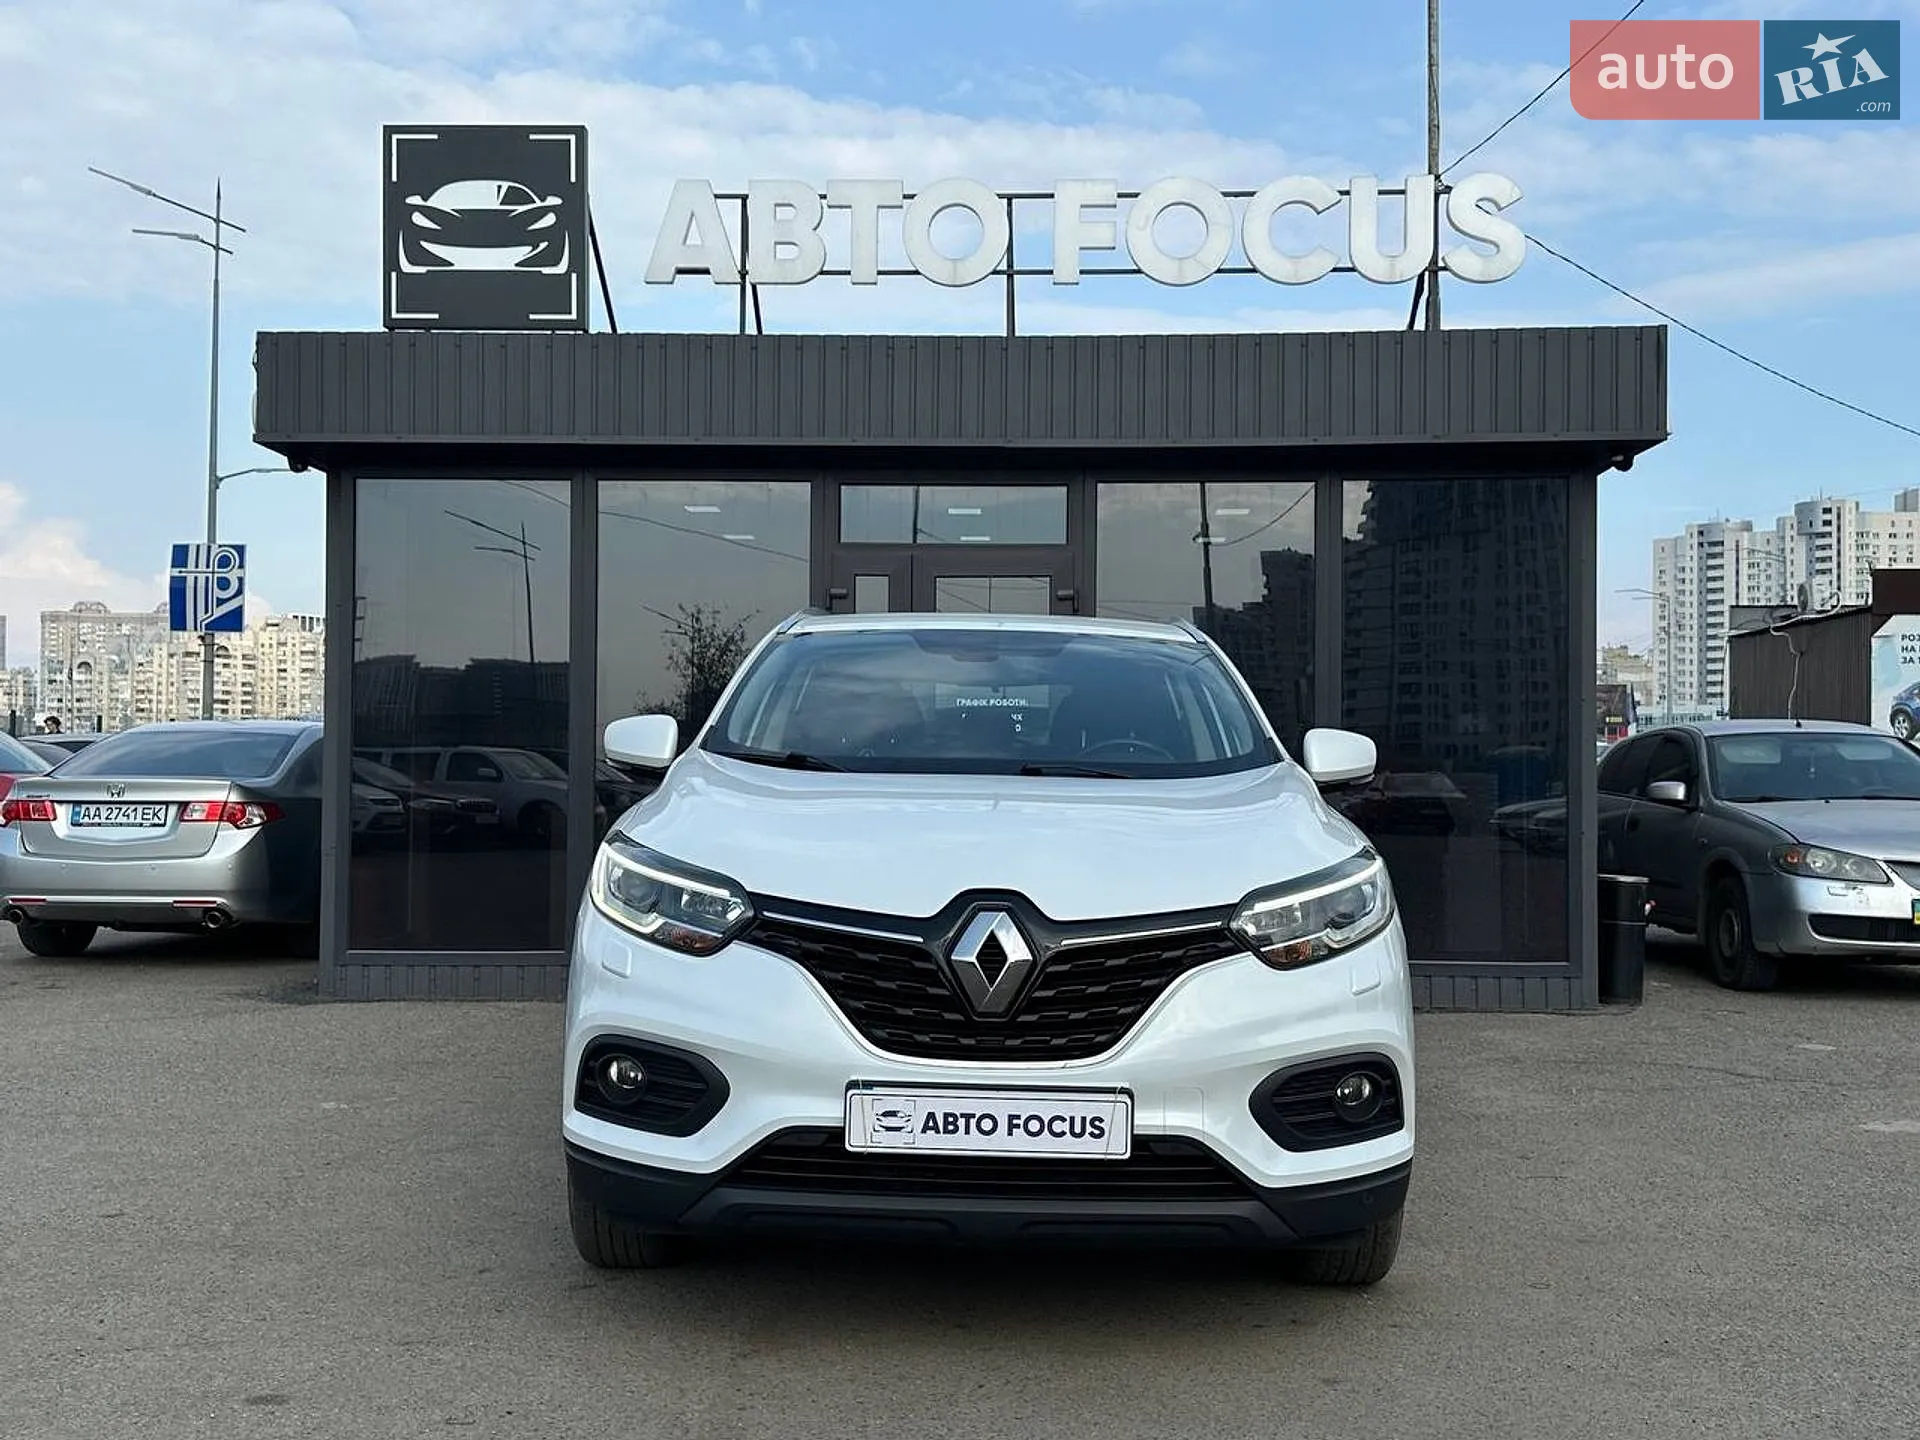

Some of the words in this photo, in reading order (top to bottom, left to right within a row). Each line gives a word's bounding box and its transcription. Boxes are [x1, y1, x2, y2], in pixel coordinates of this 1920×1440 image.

[643, 177, 1010, 287] АВТО
[1053, 173, 1527, 287] FOCUS
[81, 806, 102, 821] AA
[104, 806, 139, 821] 2741
[141, 806, 162, 821] EK
[920, 1111, 999, 1137] АВТО
[1006, 1114, 1106, 1140] FOCUS
